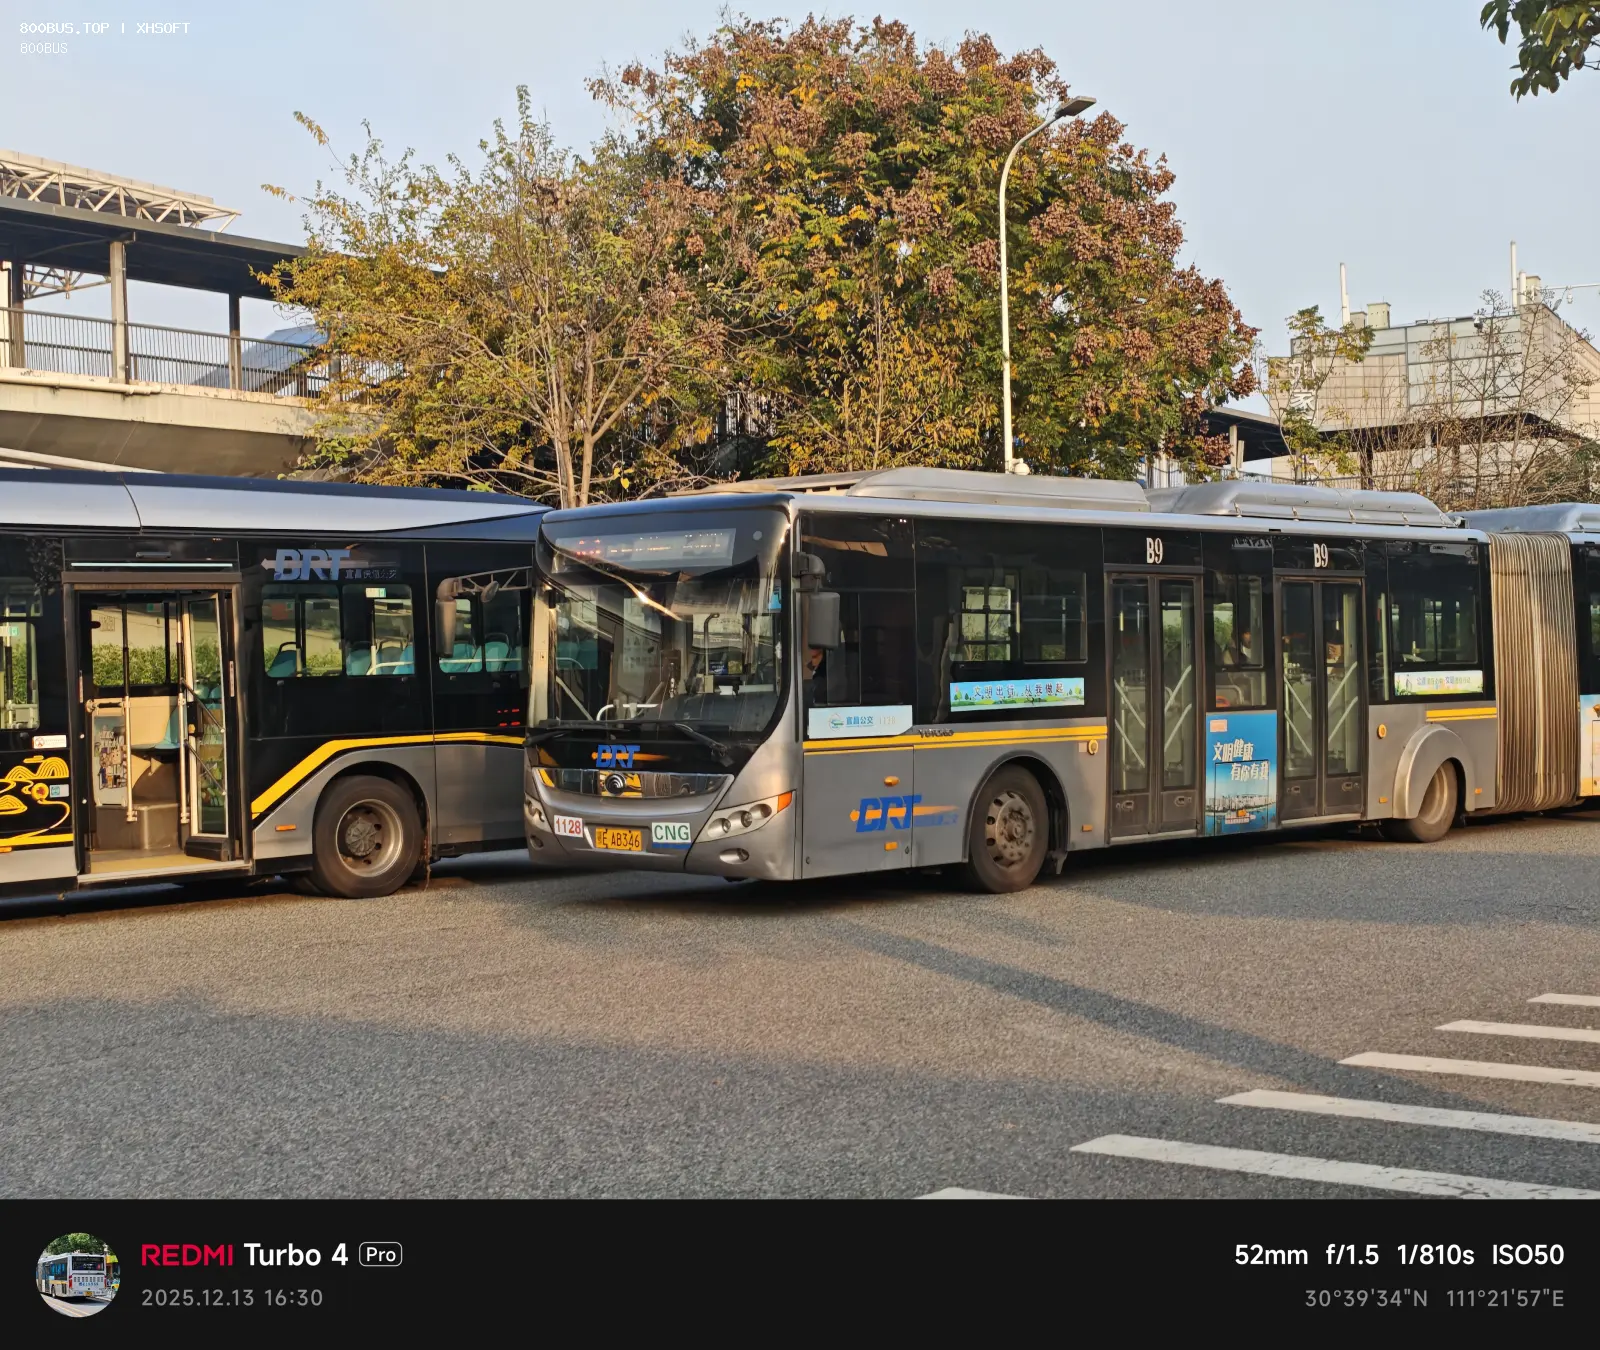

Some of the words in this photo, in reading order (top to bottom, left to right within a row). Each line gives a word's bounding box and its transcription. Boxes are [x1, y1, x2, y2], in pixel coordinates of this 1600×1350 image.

[1146, 537, 1163, 564] B9
[1313, 543, 1329, 568] B9
[274, 549, 350, 580] BRT
[596, 744, 641, 769] BRT
[1213, 739, 1254, 762] 文明健康
[856, 794, 922, 832] BRT
[555, 817, 581, 835] 1128
[654, 824, 690, 841] CNG
